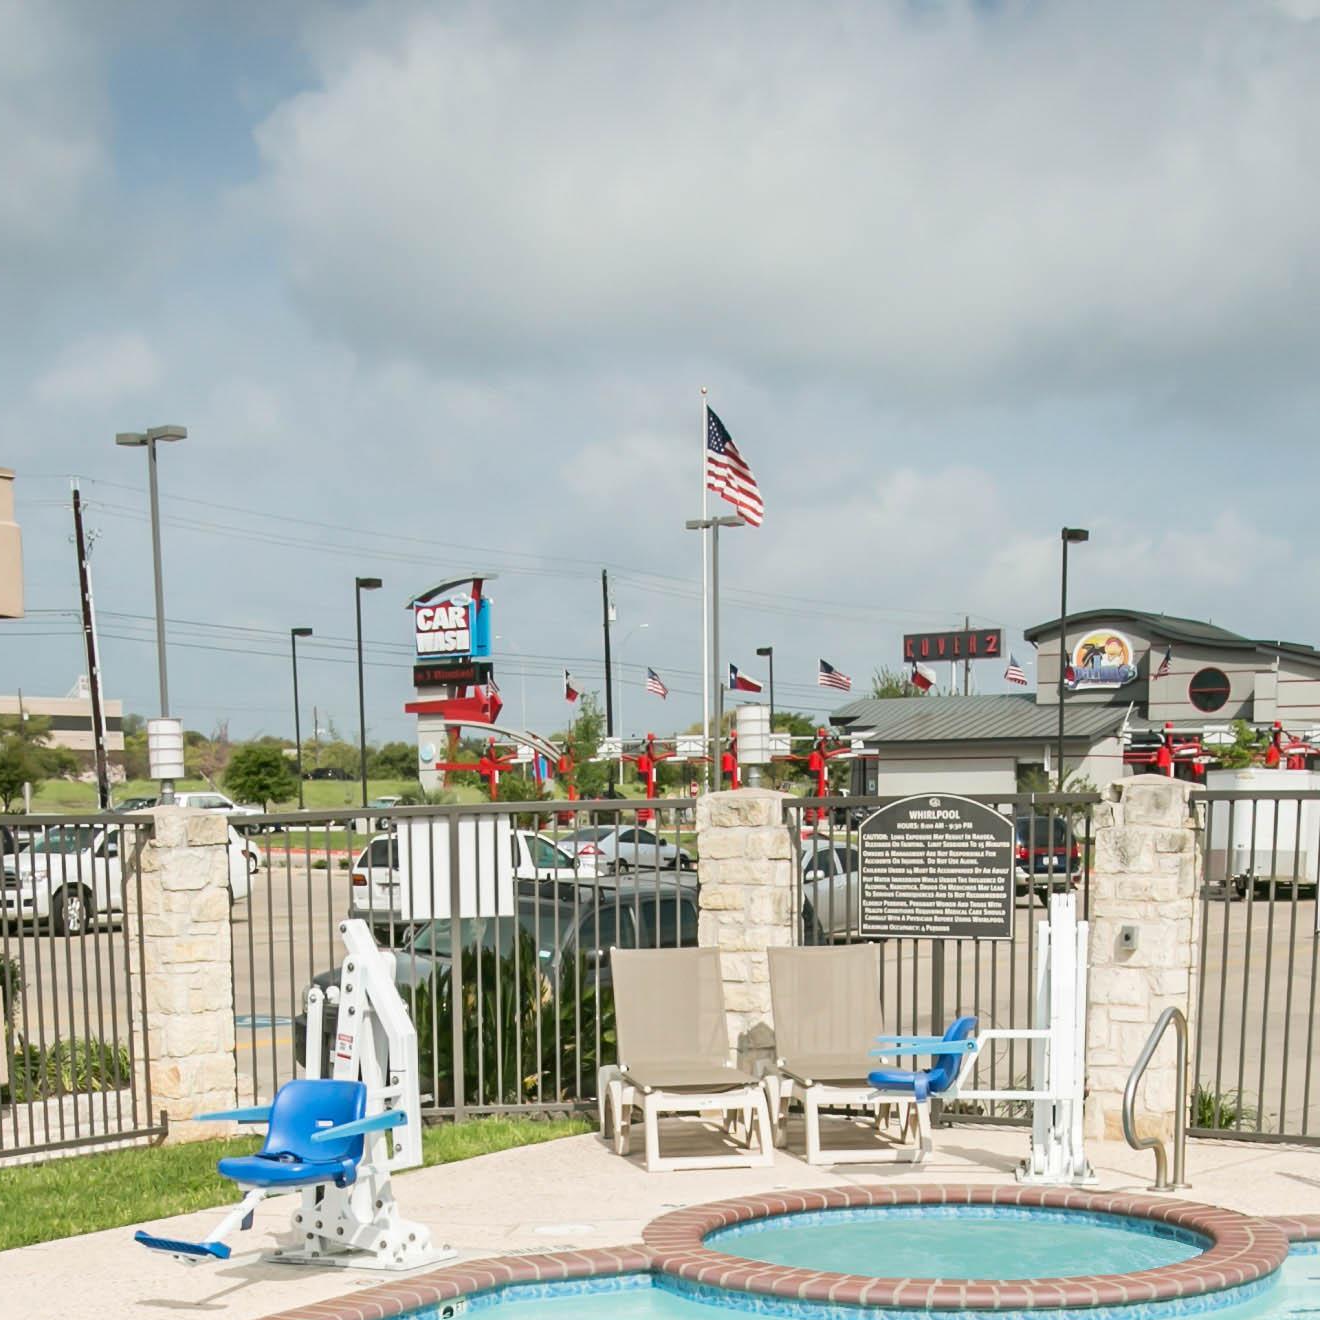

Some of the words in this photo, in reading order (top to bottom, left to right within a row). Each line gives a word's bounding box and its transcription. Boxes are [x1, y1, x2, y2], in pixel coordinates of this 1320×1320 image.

[416, 606, 467, 631] CAR
[416, 629, 470, 653] WASH
[985, 634, 998, 654] 2
[909, 810, 960, 819] WHIRLPOOL
